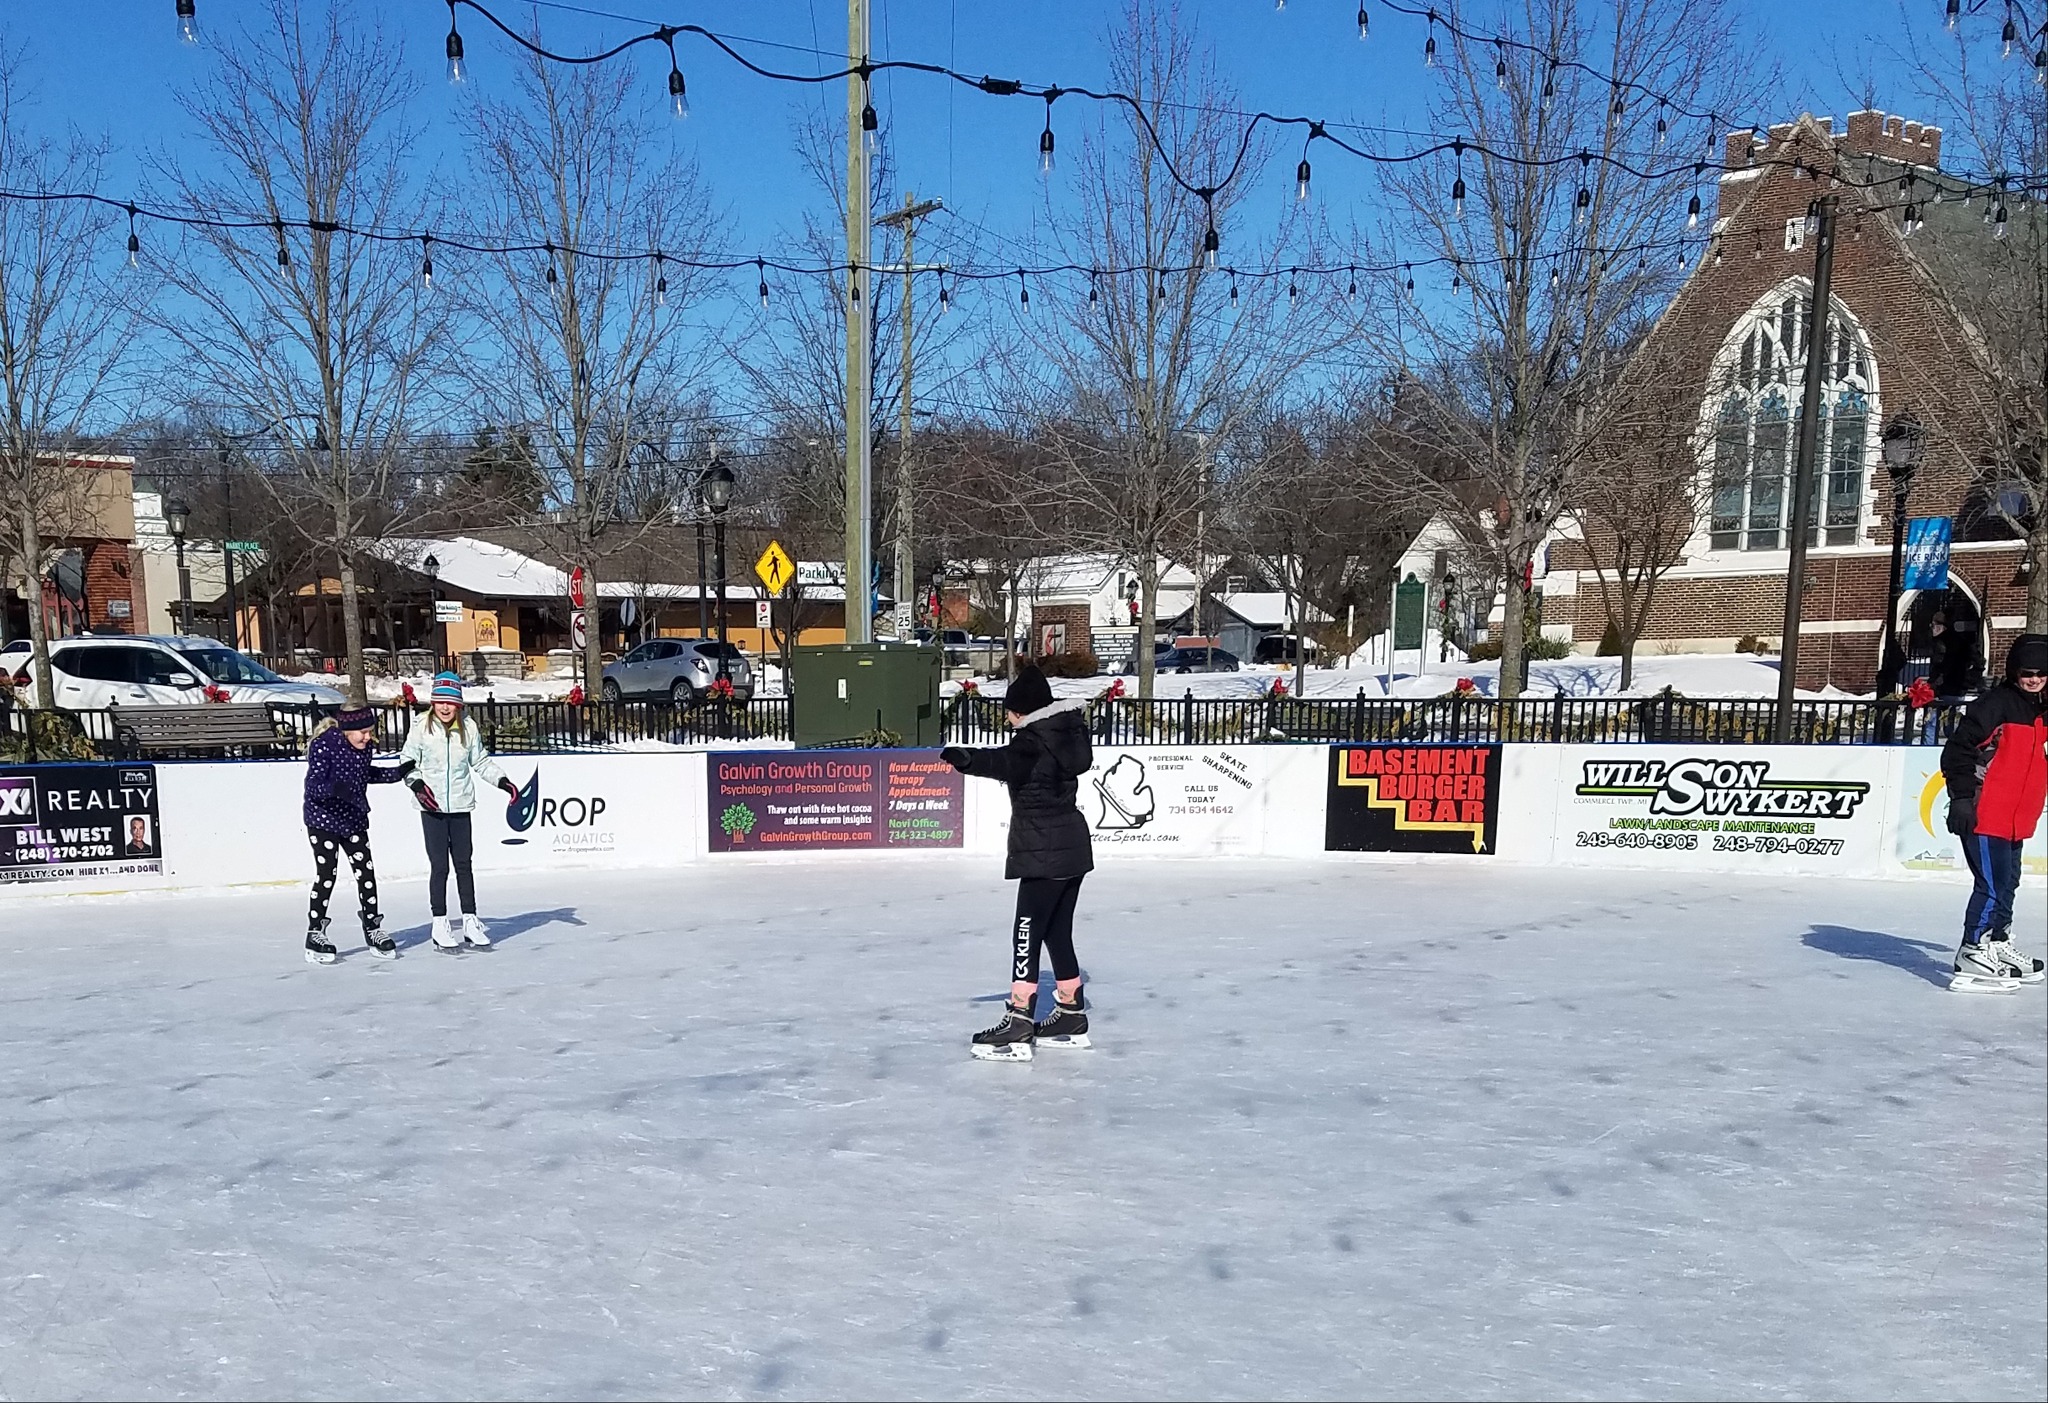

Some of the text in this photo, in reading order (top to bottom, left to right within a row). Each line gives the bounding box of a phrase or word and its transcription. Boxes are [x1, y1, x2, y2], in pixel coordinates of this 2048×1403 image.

[1909, 551, 1946, 562] ICE RINK
[798, 566, 838, 581] Parking
[572, 579, 583, 595] ST
[898, 616, 910, 627] 25
[889, 761, 952, 774] Now Accepting
[1219, 751, 1248, 773] SKATE
[1349, 749, 1490, 775] BASEMENT
[719, 761, 872, 781] Galvin Growth Group
[1202, 755, 1253, 790] SHARPENING
[889, 775, 925, 786] Therapy
[1379, 774, 1485, 800] BURGER
[720, 782, 872, 797] Psychology and Personal Growth
[888, 787, 951, 798] Appointments
[47, 788, 153, 811] REALTY
[888, 799, 949, 812] 7 Days a Week
[767, 803, 872, 815] Thaw out with free hot cocoa
[1168, 805, 1234, 814] 734 634 4642
[1408, 800, 1485, 822] BAR
[784, 814, 872, 826] and some warm insights
[888, 818, 940, 828] Novi Office
[1722, 820, 1815, 835] MAINTENANCE
[16, 827, 112, 846] BILL WEST
[553, 832, 615, 845] AQUATICS
[760, 831, 872, 843] GalvinGrowthGroup.com
[888, 830, 954, 840] 734-323-4897
[1576, 832, 1844, 855] 248-640-8905 248-794-0277
[15, 845, 114, 862] (248) 270-2702
[79, 867, 97, 876] HIRE
[137, 864, 159, 873] DONE
[1016, 916, 1032, 957] KLEIN
